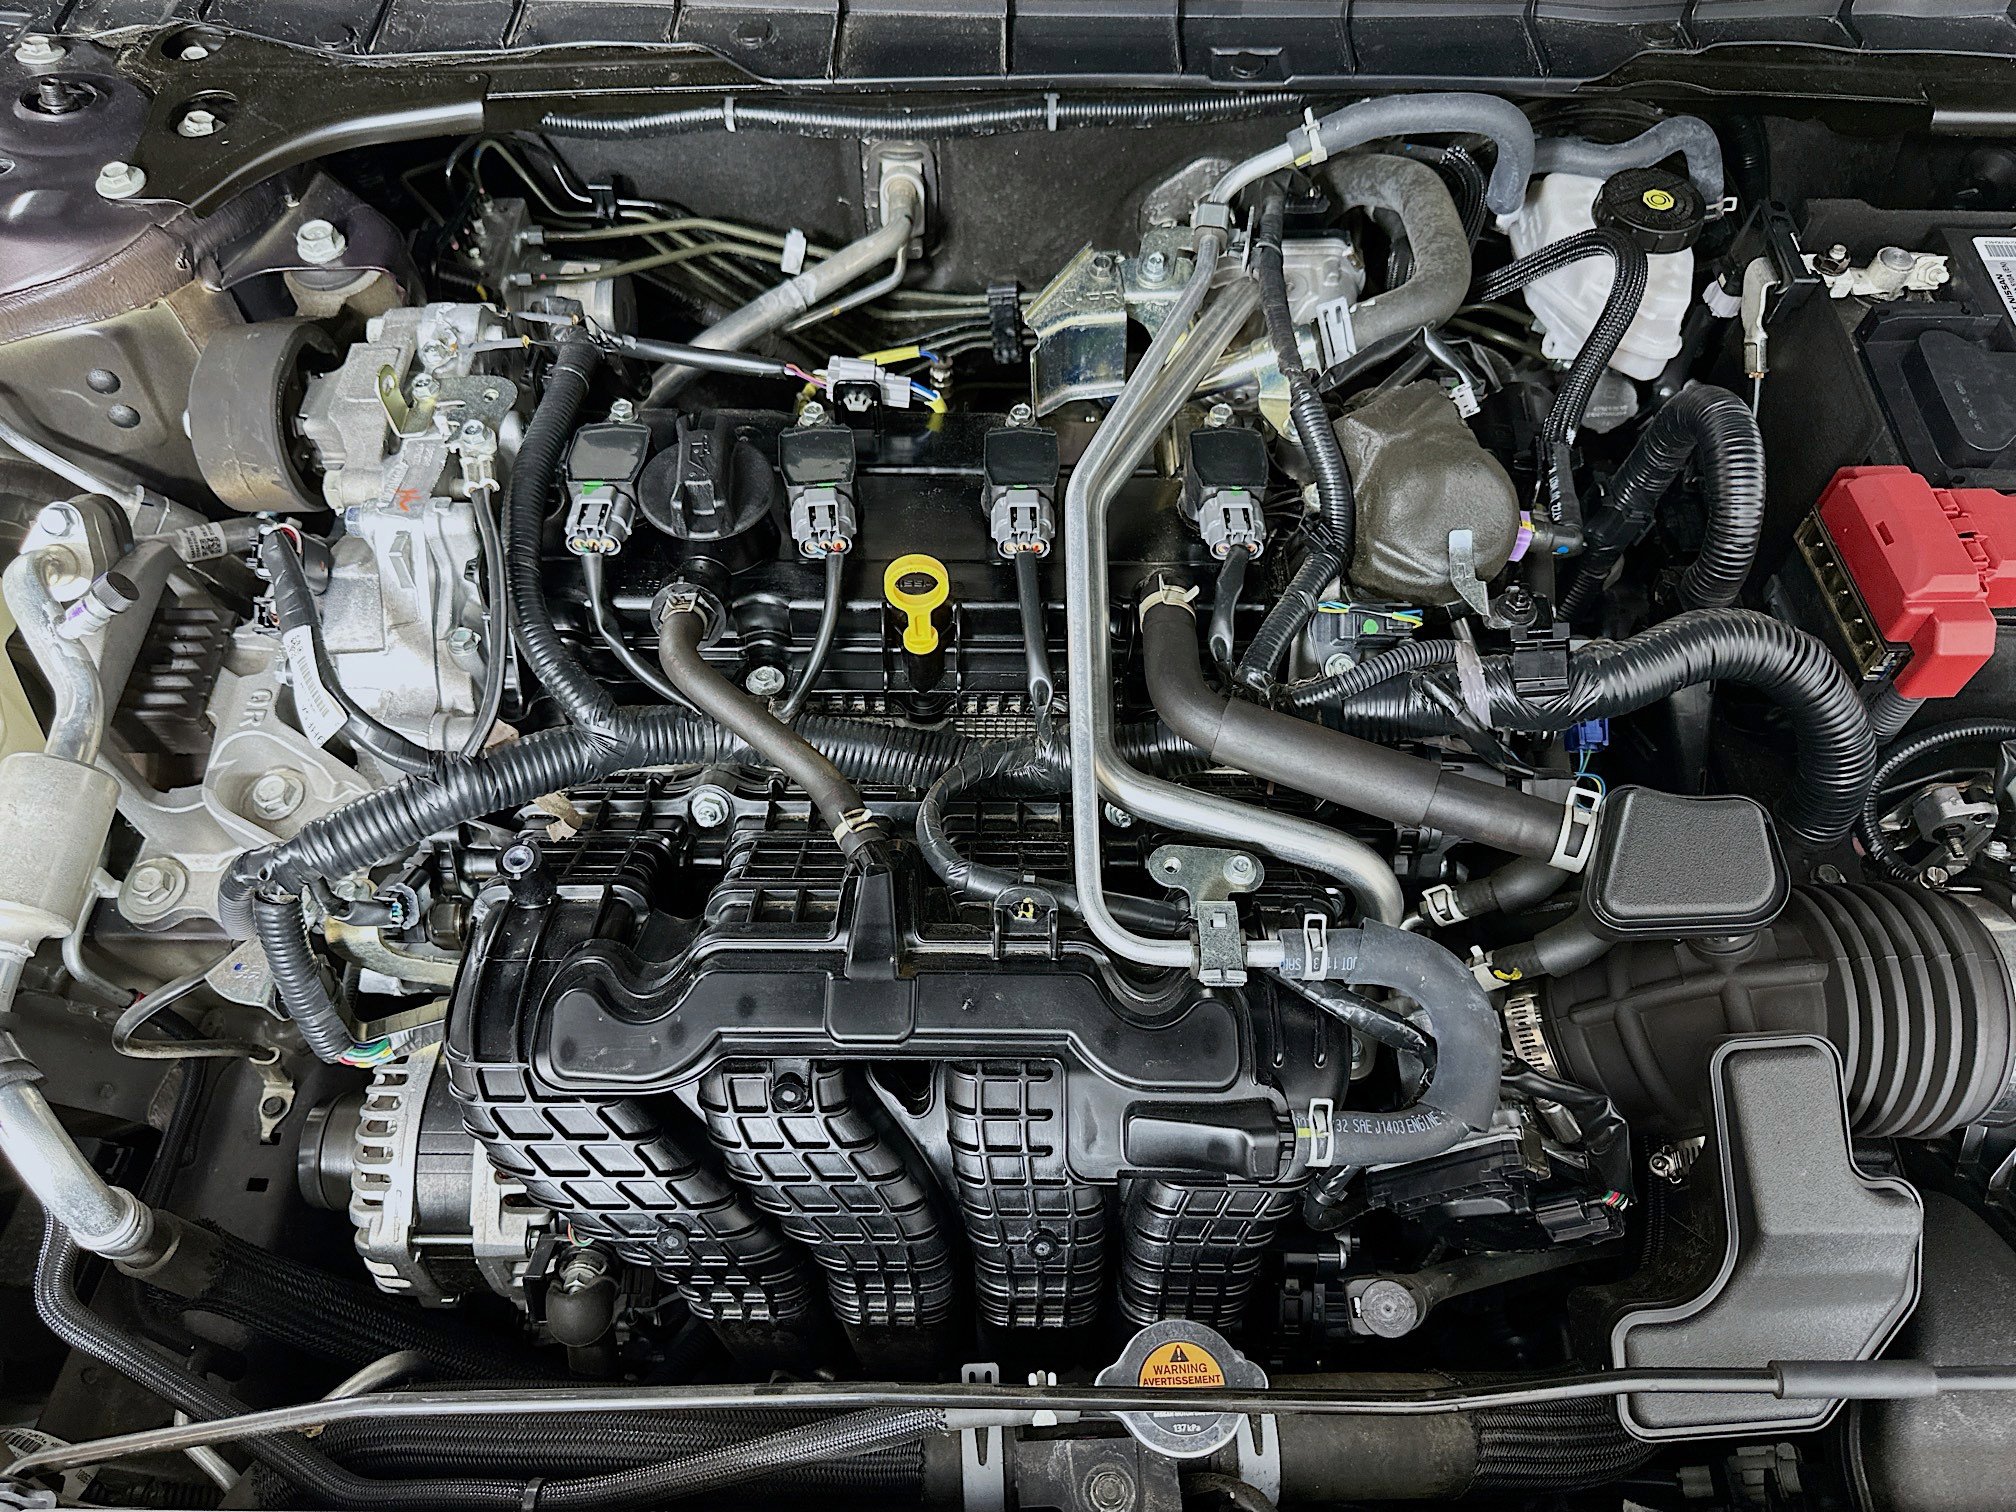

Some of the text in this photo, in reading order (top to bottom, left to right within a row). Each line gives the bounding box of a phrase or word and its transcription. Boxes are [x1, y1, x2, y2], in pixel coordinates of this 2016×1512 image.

[1996, 274, 2016, 304] NISSAN
[1352, 1118, 1373, 1134] SAE
[1375, 1119, 1406, 1135] J1403
[1405, 1110, 1442, 1134] ENGINE
[1153, 1362, 1208, 1375] WARNING
[1143, 1374, 1221, 1387] AVERTISSEMENT
[1172, 1423, 1202, 1433] 137 kPa
